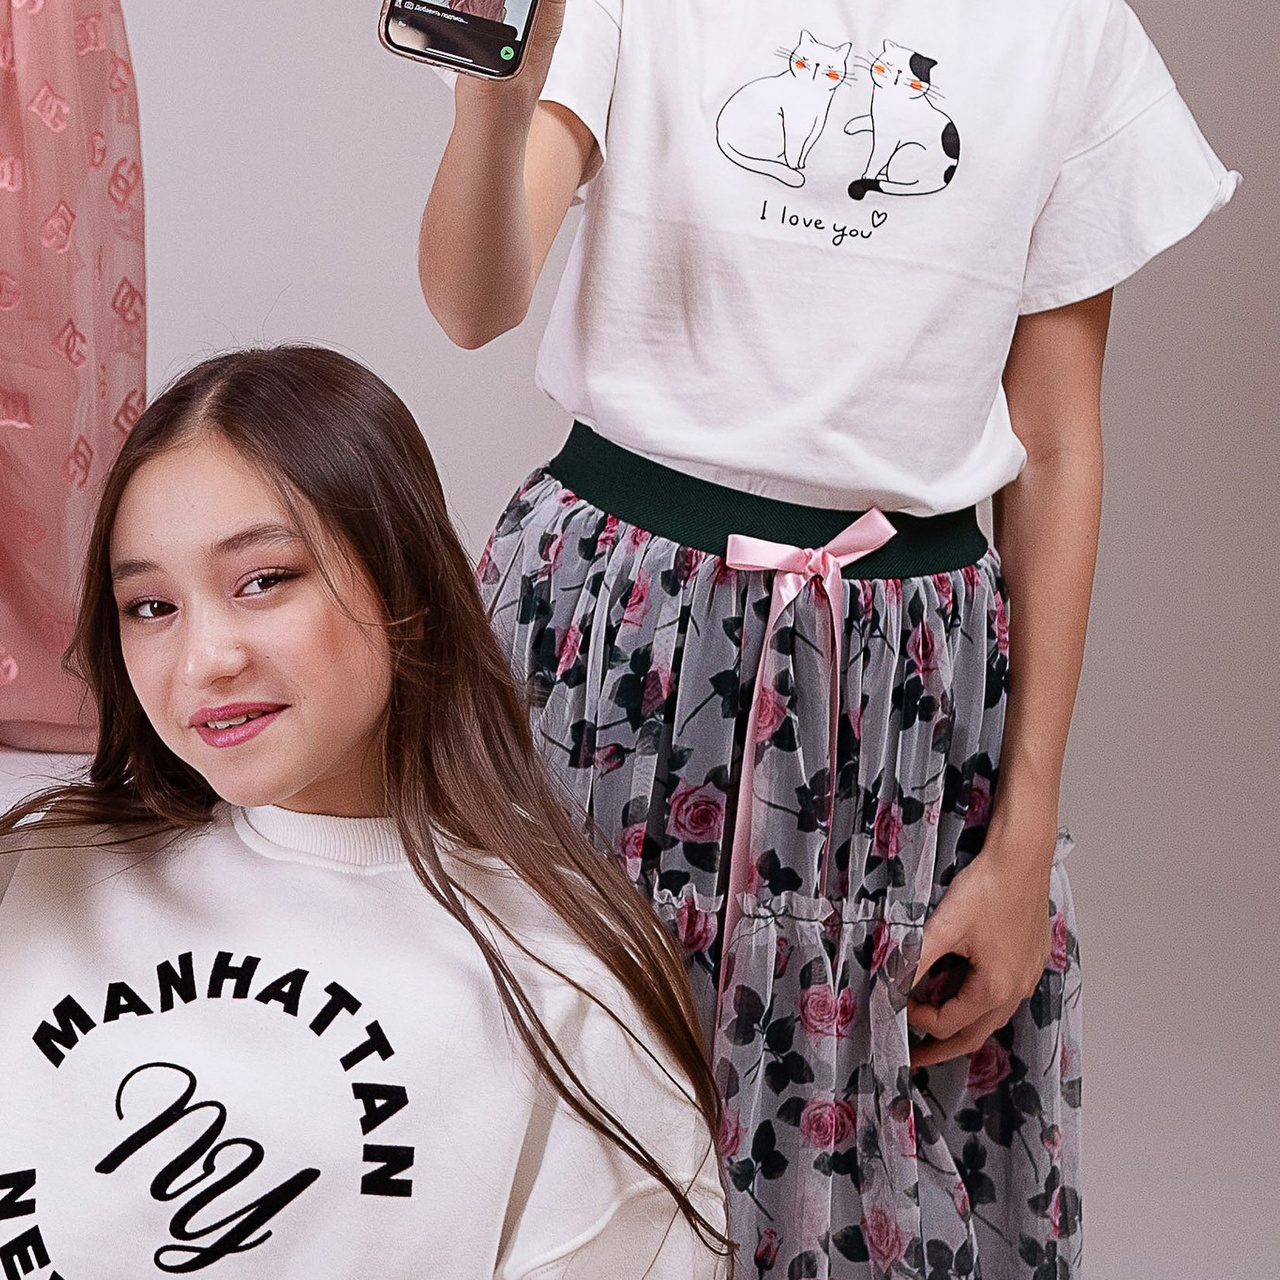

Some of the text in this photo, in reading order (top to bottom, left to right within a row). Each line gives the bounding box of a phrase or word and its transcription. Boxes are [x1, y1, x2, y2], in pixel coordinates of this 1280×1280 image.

[28, 80, 70, 132] DG
[760, 200, 873, 246] I love you
[32, 951, 415, 1197] MANHATTAN
[94, 1062, 322, 1274] NY
